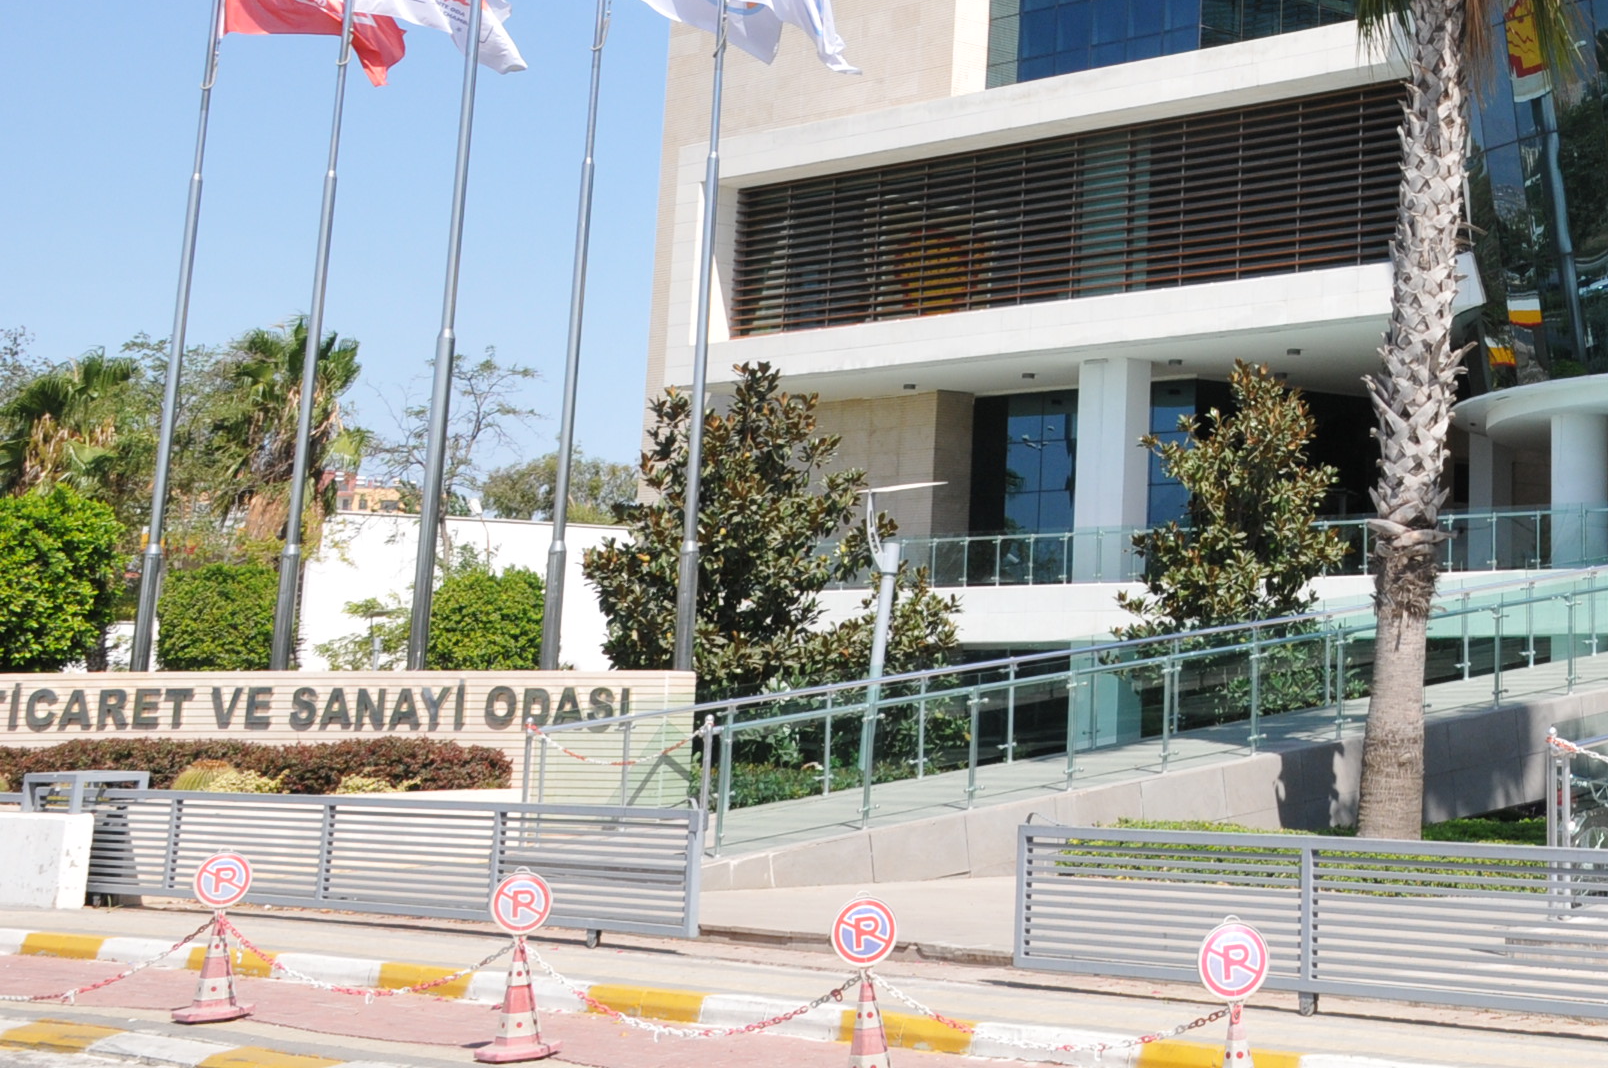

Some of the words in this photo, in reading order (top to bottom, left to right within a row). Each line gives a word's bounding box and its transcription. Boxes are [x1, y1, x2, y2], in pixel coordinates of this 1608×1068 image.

[0, 683, 194, 731] İCARET
[211, 687, 273, 729] VE
[290, 679, 465, 731] SANAYİ
[485, 686, 632, 732] ODASI
